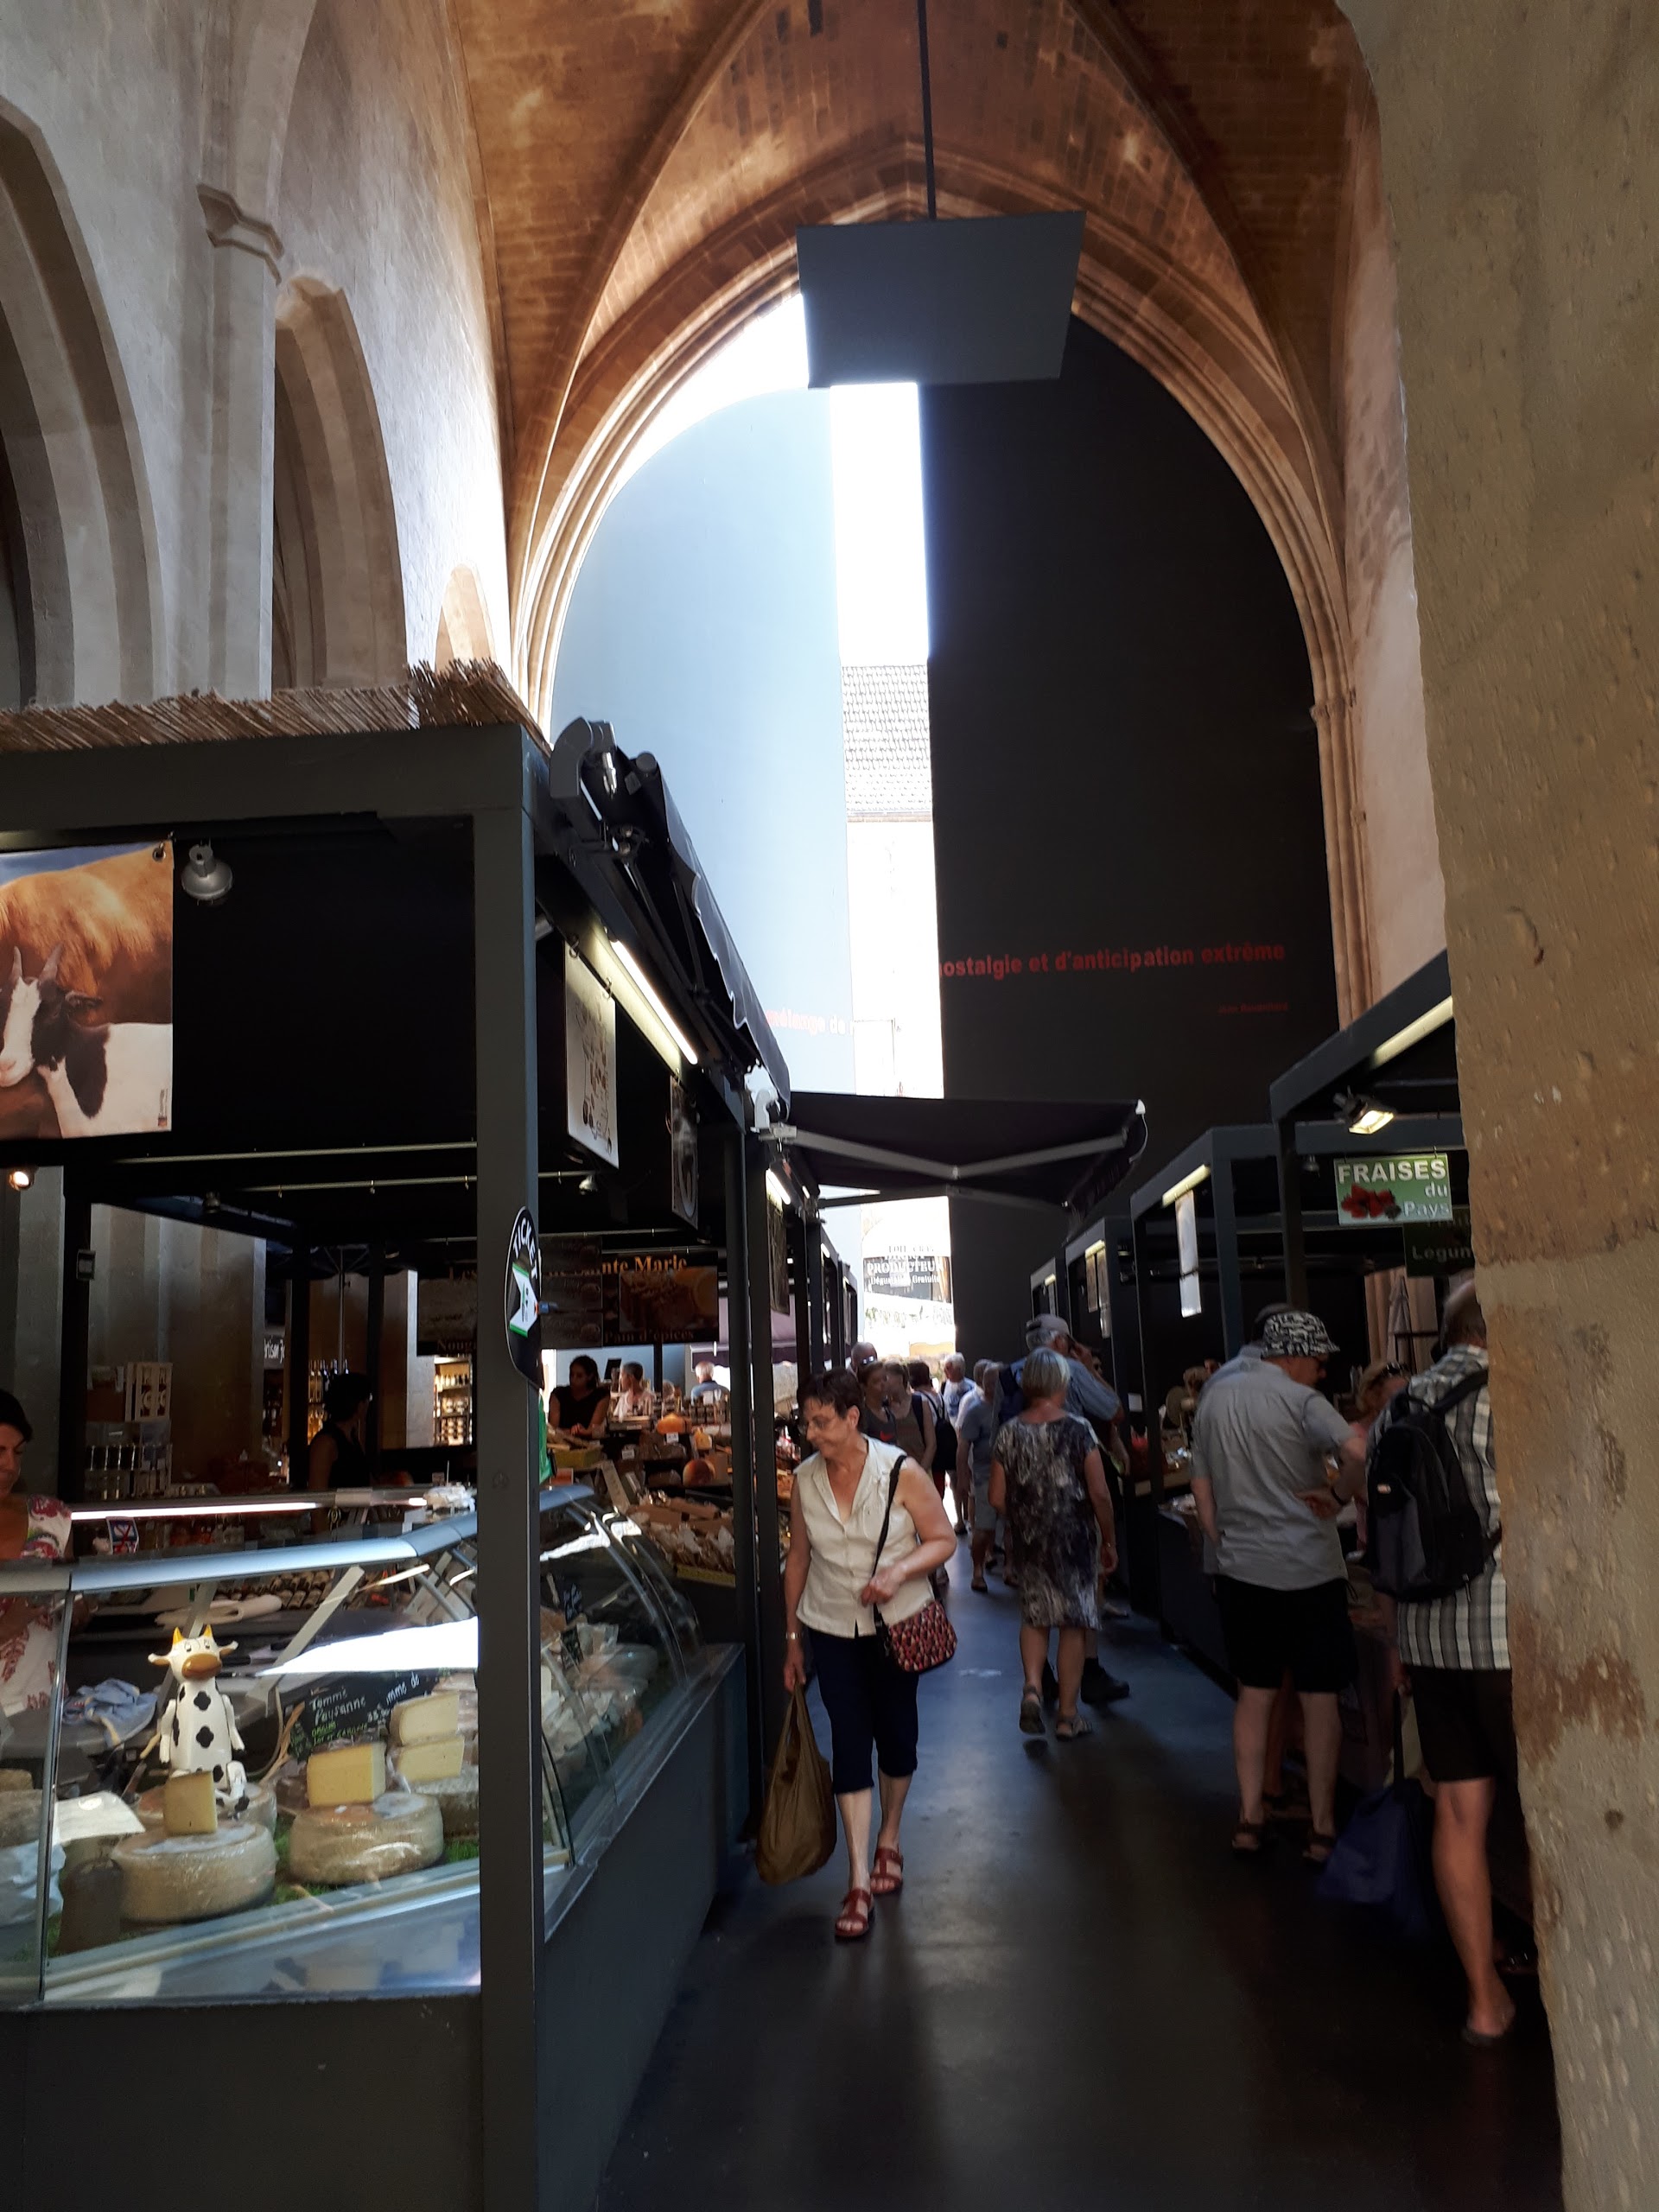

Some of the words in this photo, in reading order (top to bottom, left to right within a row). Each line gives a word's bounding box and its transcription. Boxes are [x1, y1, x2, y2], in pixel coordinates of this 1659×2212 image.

[1028, 955, 1048, 973] et
[1055, 944, 1195, 972] d'anticipation
[1200, 939, 1286, 963] extrême
[1337, 1159, 1447, 1185] FRAISES
[1425, 1180, 1449, 1198] du
[1402, 1199, 1450, 1219] Pays
[512, 1216, 537, 1281] TICKET
